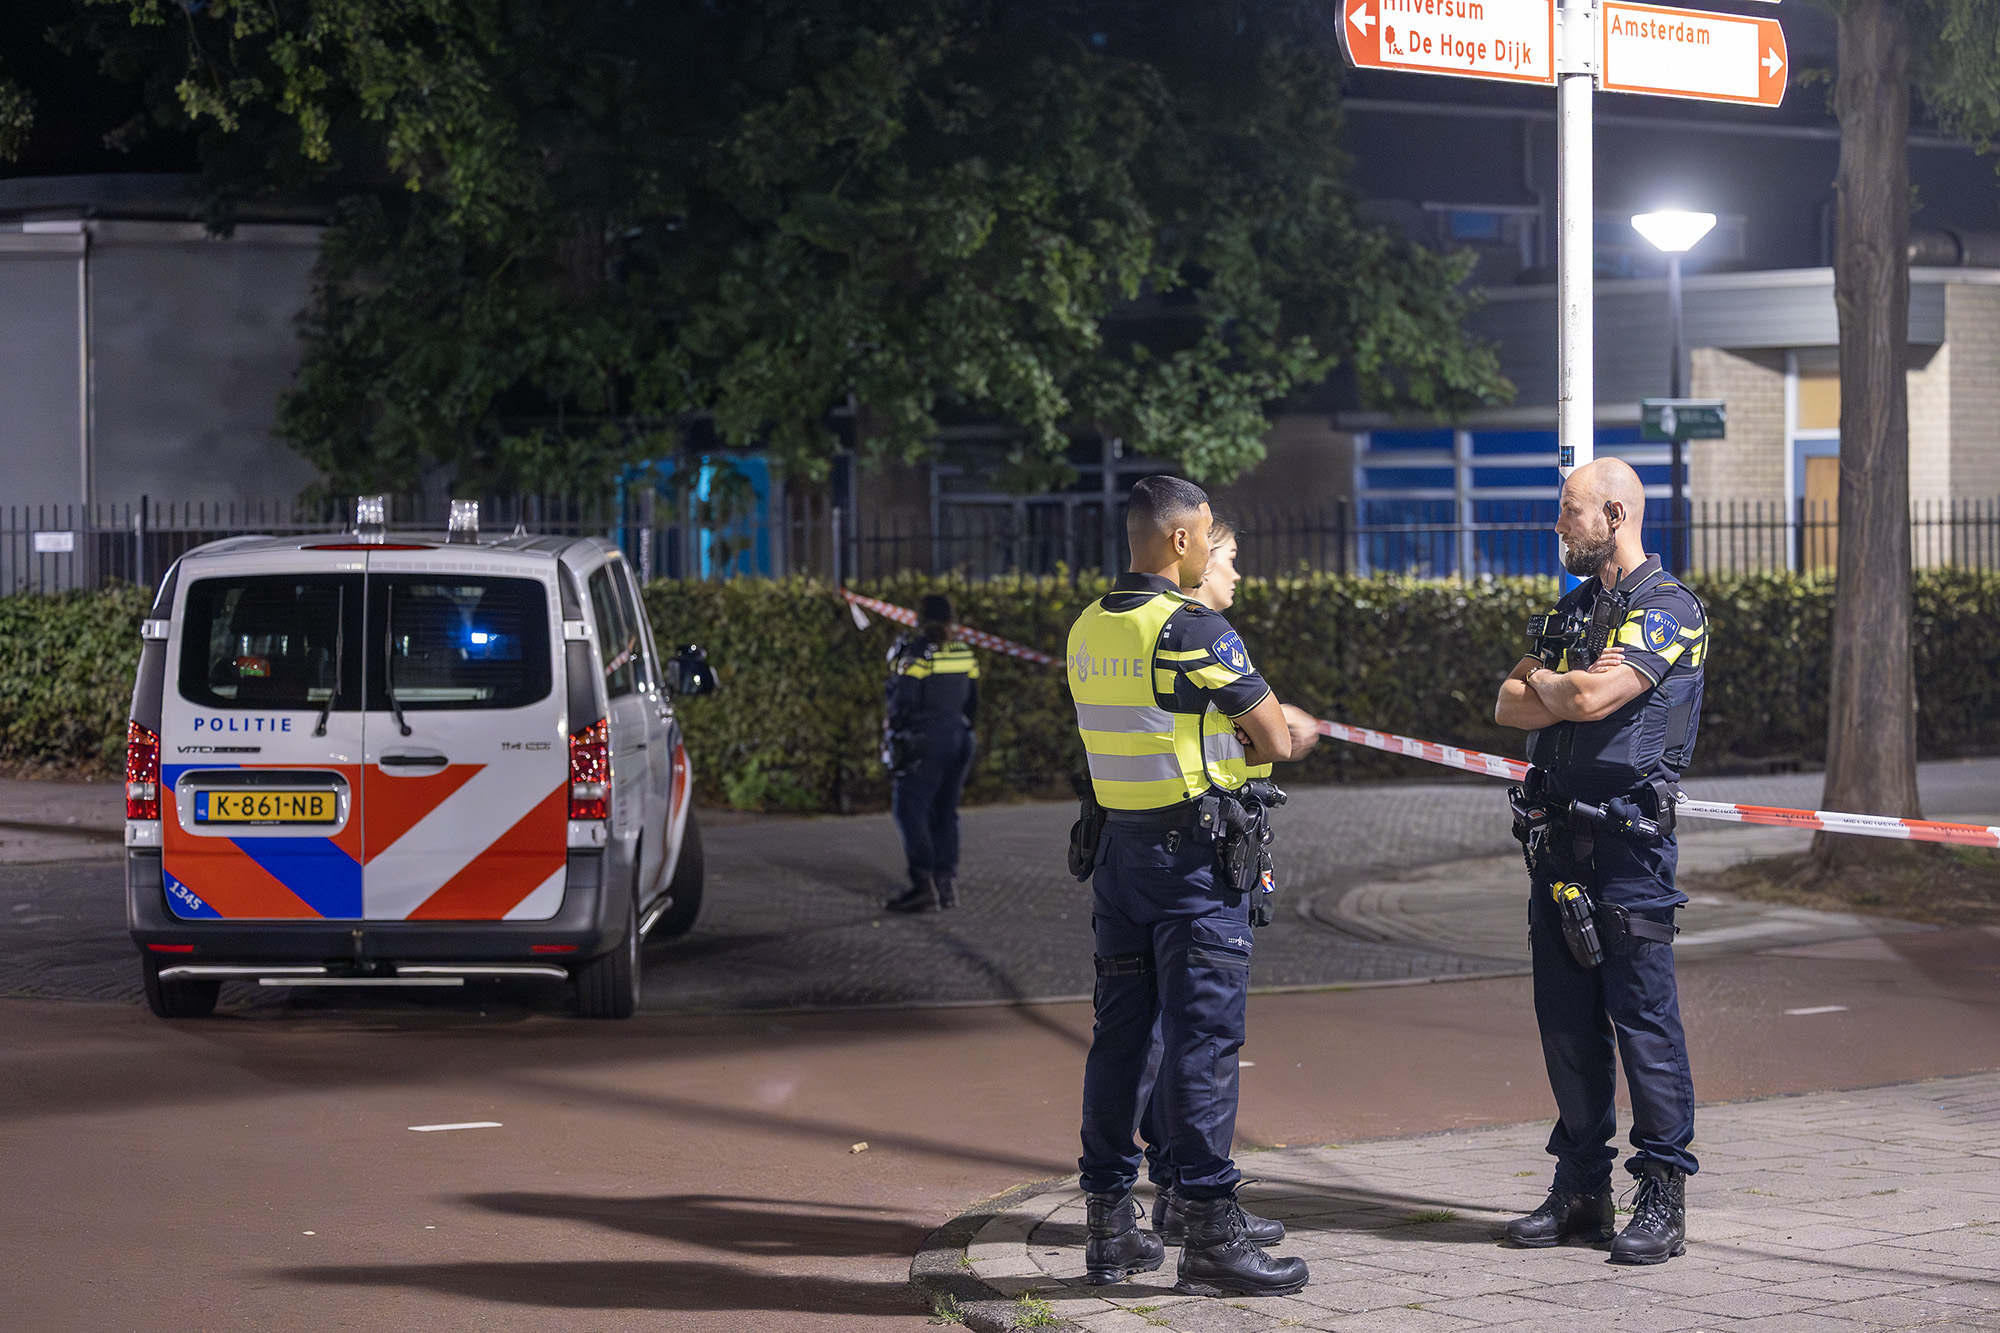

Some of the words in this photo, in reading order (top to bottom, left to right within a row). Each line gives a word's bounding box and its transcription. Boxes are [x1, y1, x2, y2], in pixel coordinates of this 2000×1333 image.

[1611, 14, 1710, 45] Amsterdam
[1409, 30, 1432, 54] De
[1441, 33, 1486, 66] Hoge
[1495, 39, 1531, 70] Dijk
[194, 717, 292, 732] POLITIE
[216, 795, 324, 817] K-861-NB
[169, 881, 203, 911] 1345
